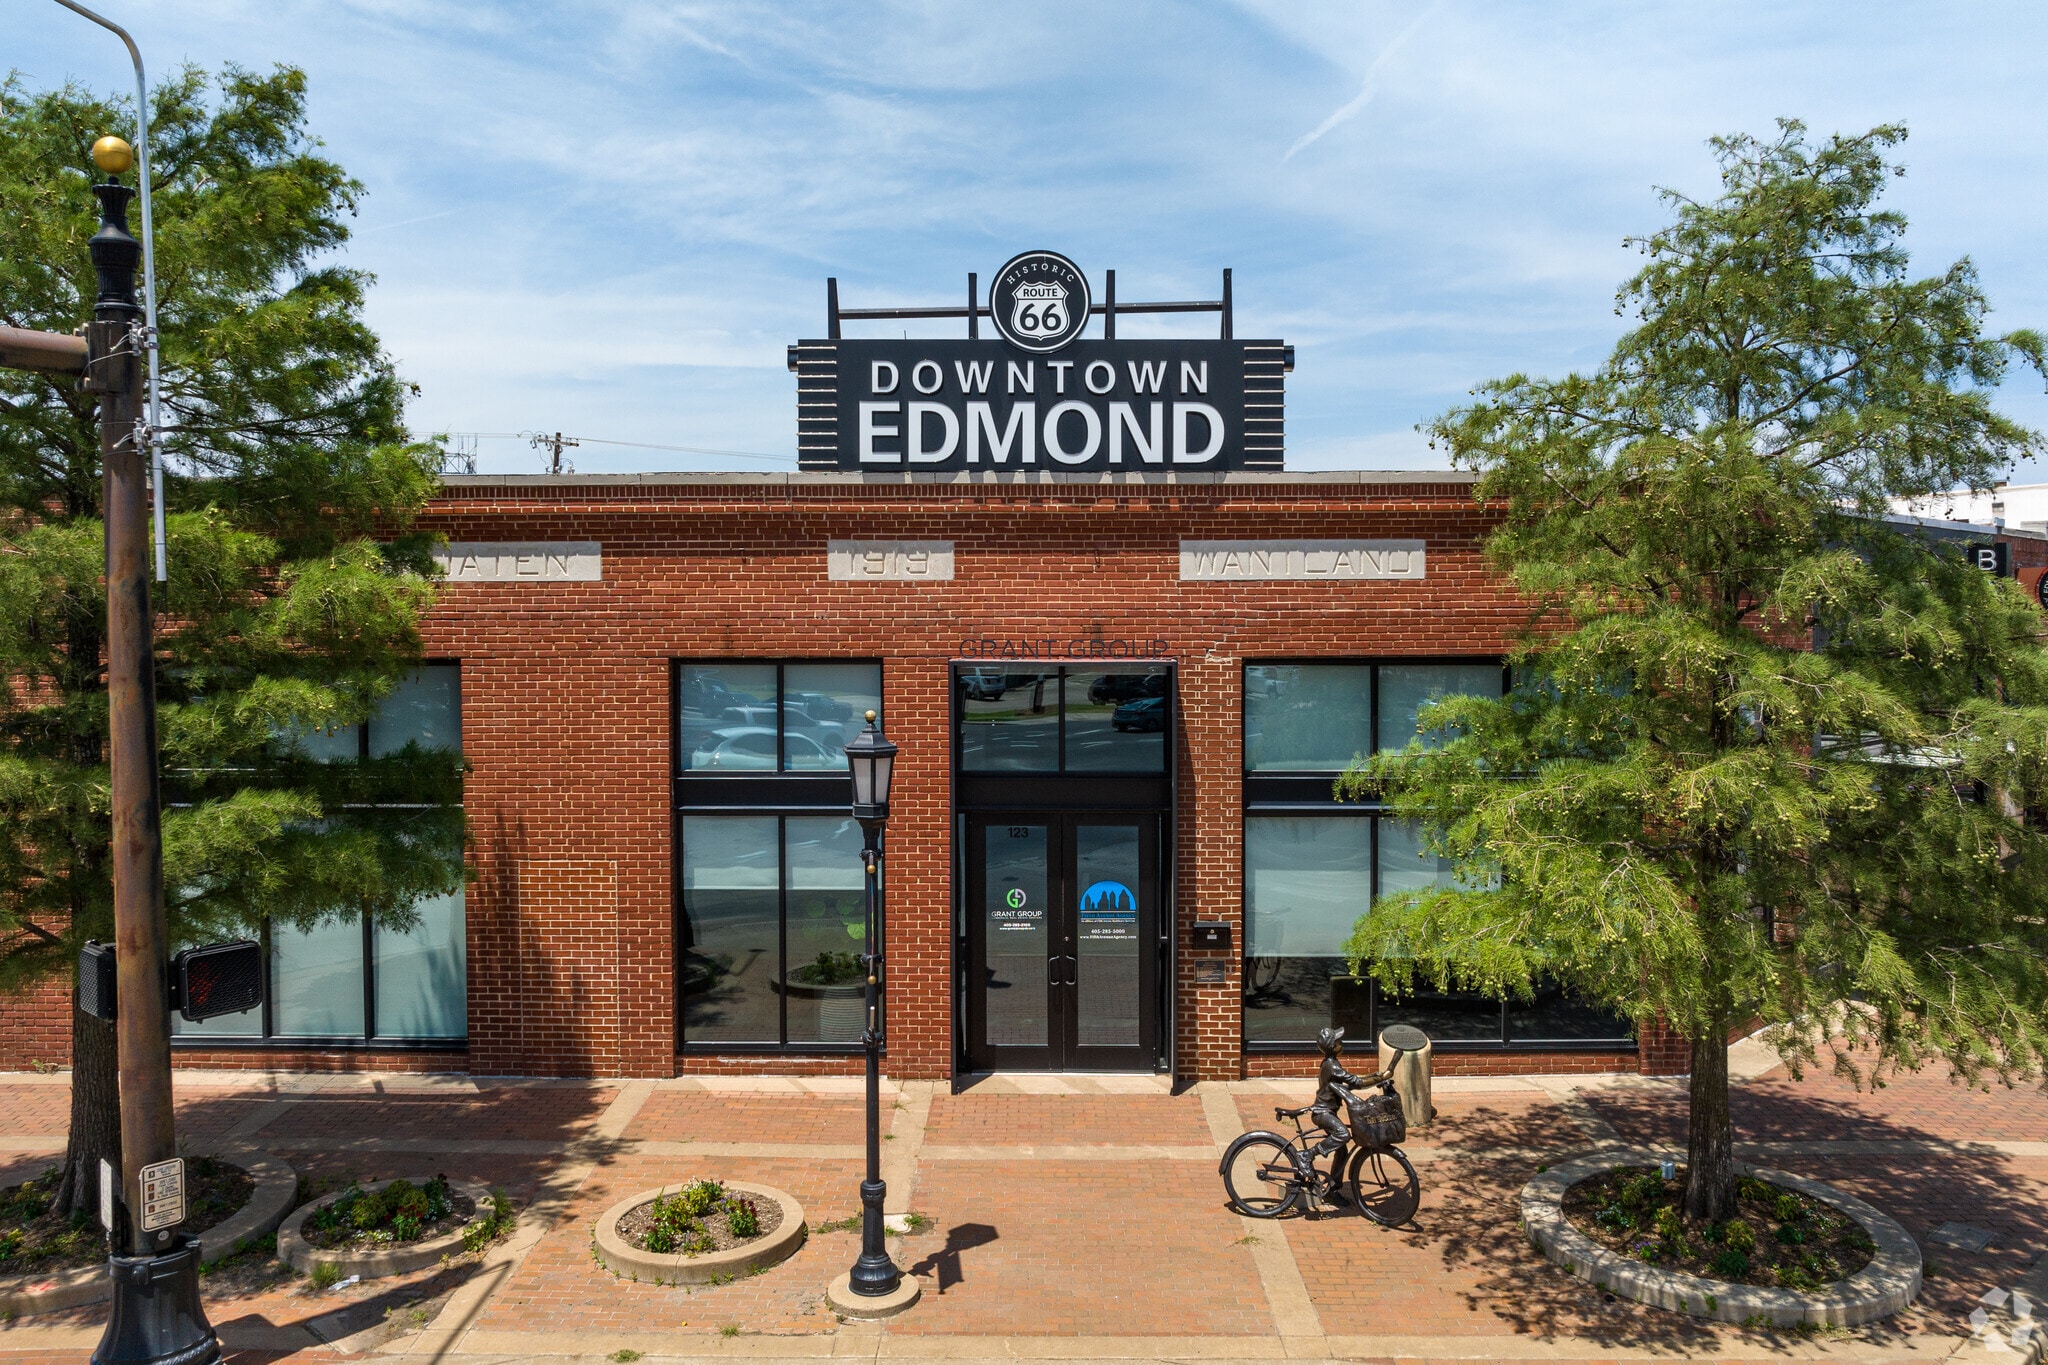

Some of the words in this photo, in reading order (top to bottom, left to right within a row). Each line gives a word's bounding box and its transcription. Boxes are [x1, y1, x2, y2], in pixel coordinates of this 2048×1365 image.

[1006, 263, 1075, 285] HISTORIC
[1023, 288, 1058, 297] ROUTE
[1019, 303, 1062, 331] 66
[871, 359, 1208, 395] DOWNTOWN
[858, 400, 1226, 464] EDMOND
[850, 546, 931, 576] 1919
[1192, 546, 1412, 576] WANTLAND
[958, 638, 1059, 660] GRANT
[1067, 638, 1169, 660] GROUP
[1008, 827, 1028, 838] 123
